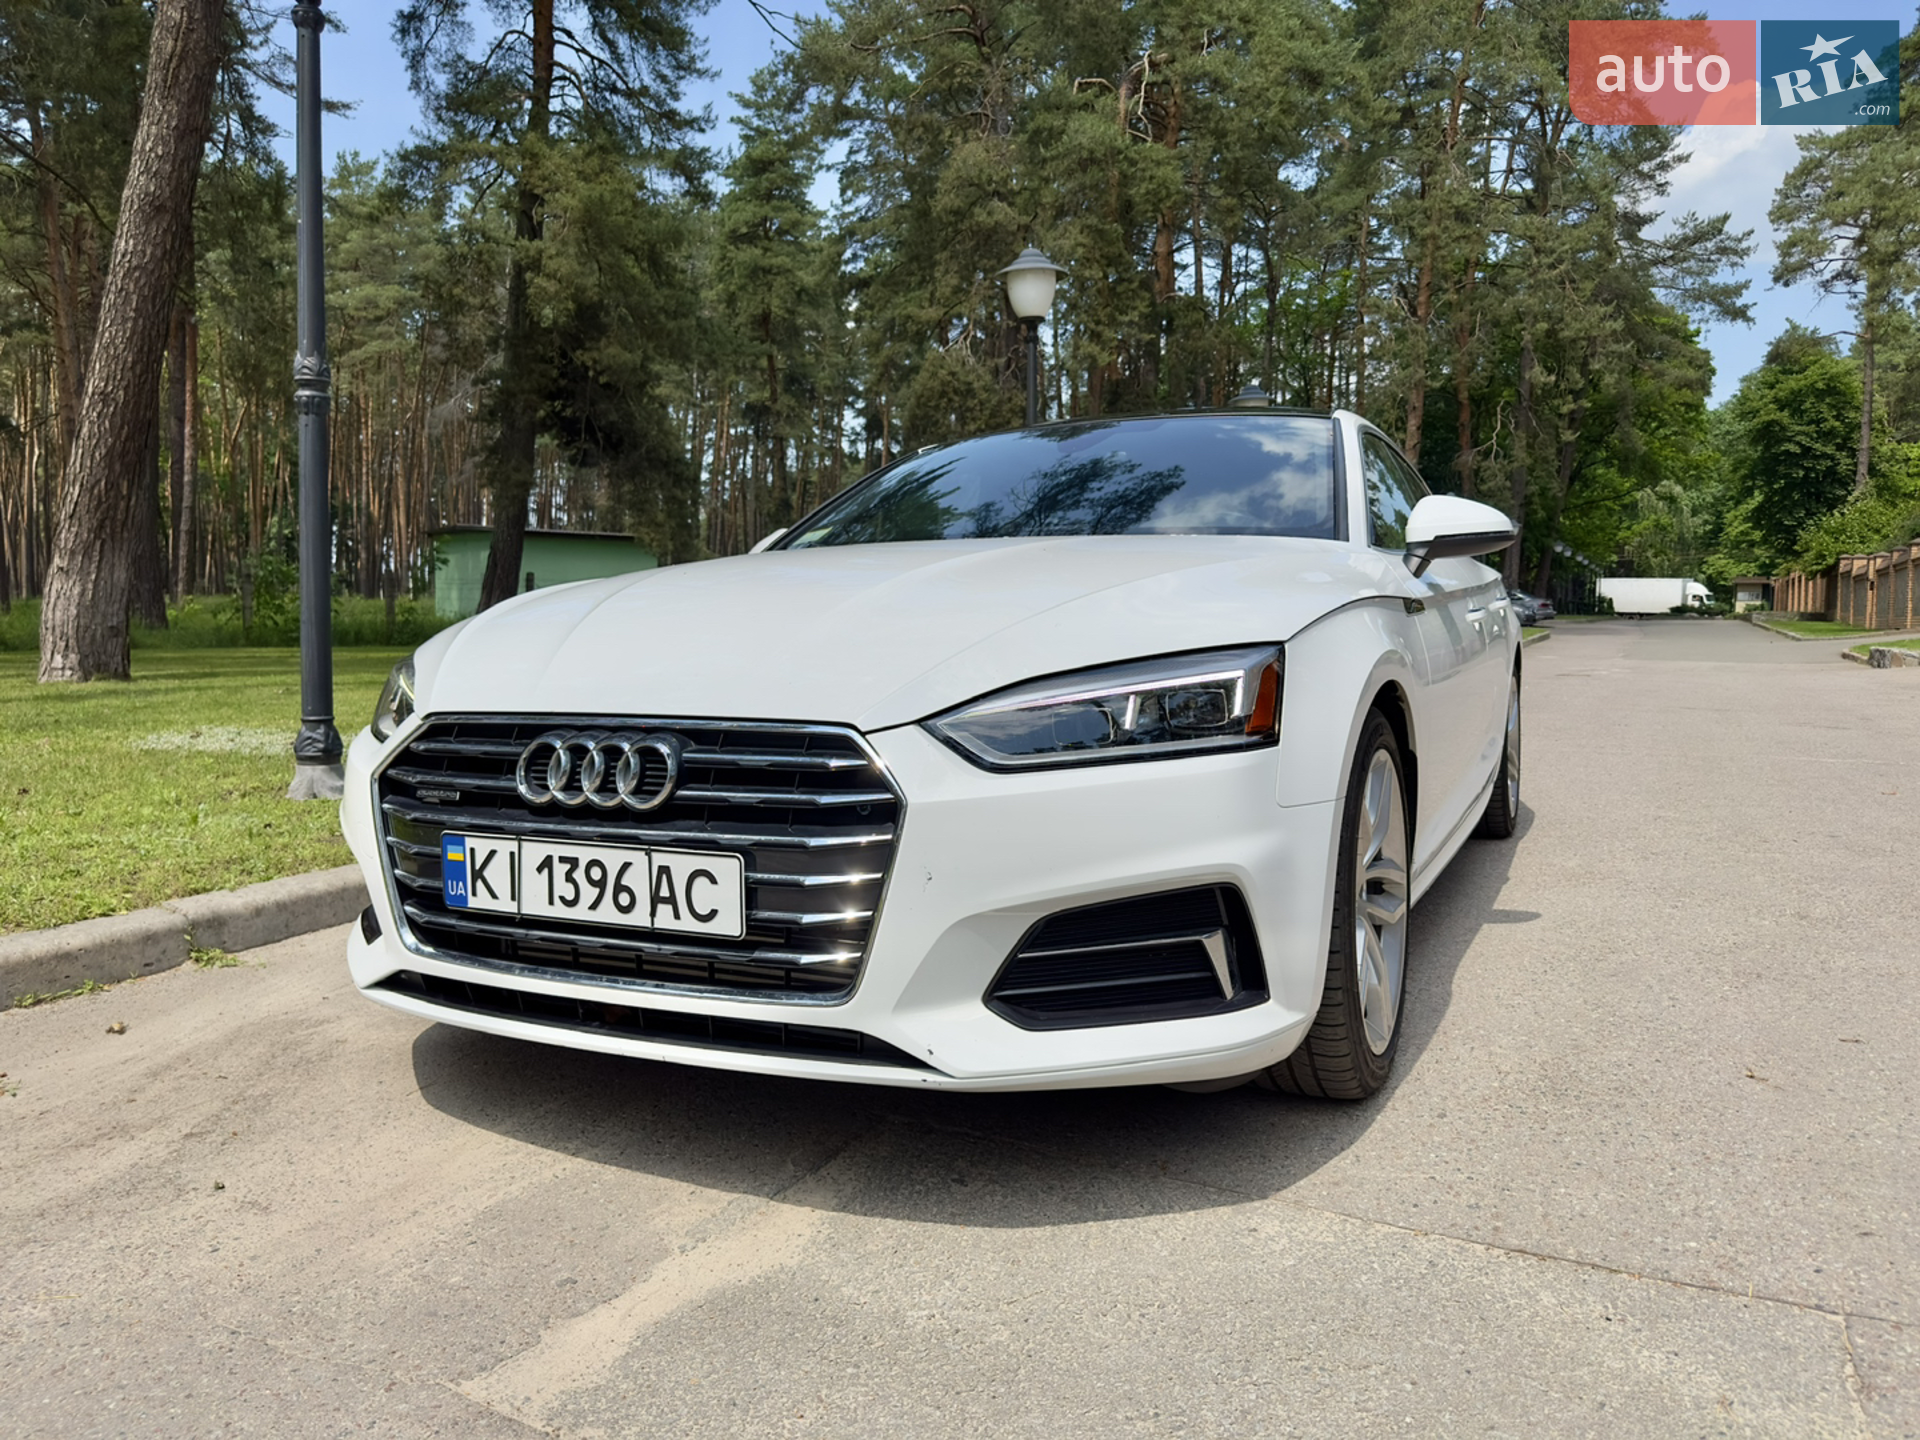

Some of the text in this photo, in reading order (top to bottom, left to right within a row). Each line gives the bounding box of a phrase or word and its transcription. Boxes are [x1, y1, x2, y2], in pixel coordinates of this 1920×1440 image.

[448, 879, 466, 897] UA
[469, 847, 719, 924] KI 1396 AC
